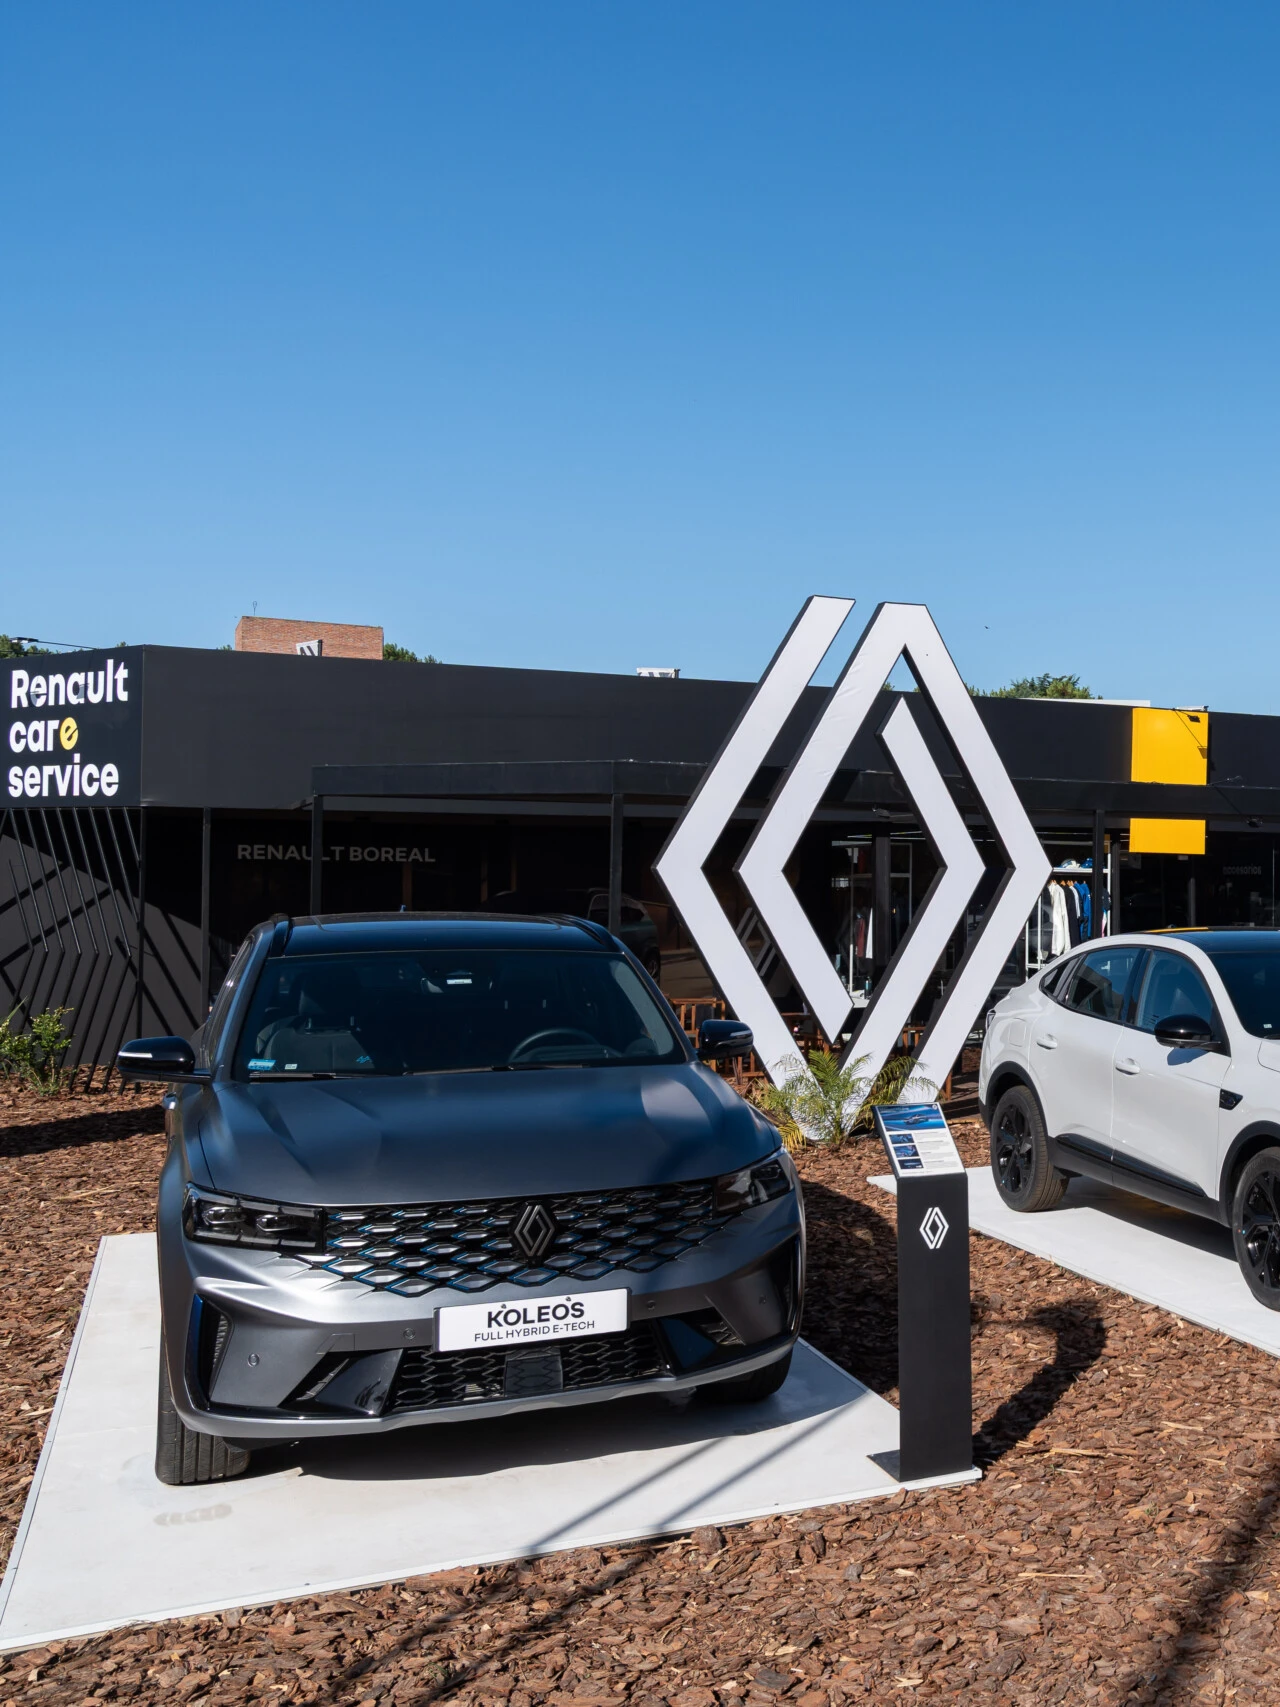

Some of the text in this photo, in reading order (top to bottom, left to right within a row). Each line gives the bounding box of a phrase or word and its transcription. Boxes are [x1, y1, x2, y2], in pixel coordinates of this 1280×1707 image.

[10, 658, 128, 708] Renault
[9, 717, 78, 753] care
[8, 753, 119, 798] service
[349, 846, 435, 862] BOREAL
[487, 1301, 585, 1328] KOLEOS
[474, 1320, 595, 1342] FULL HYBRID E-TECH
